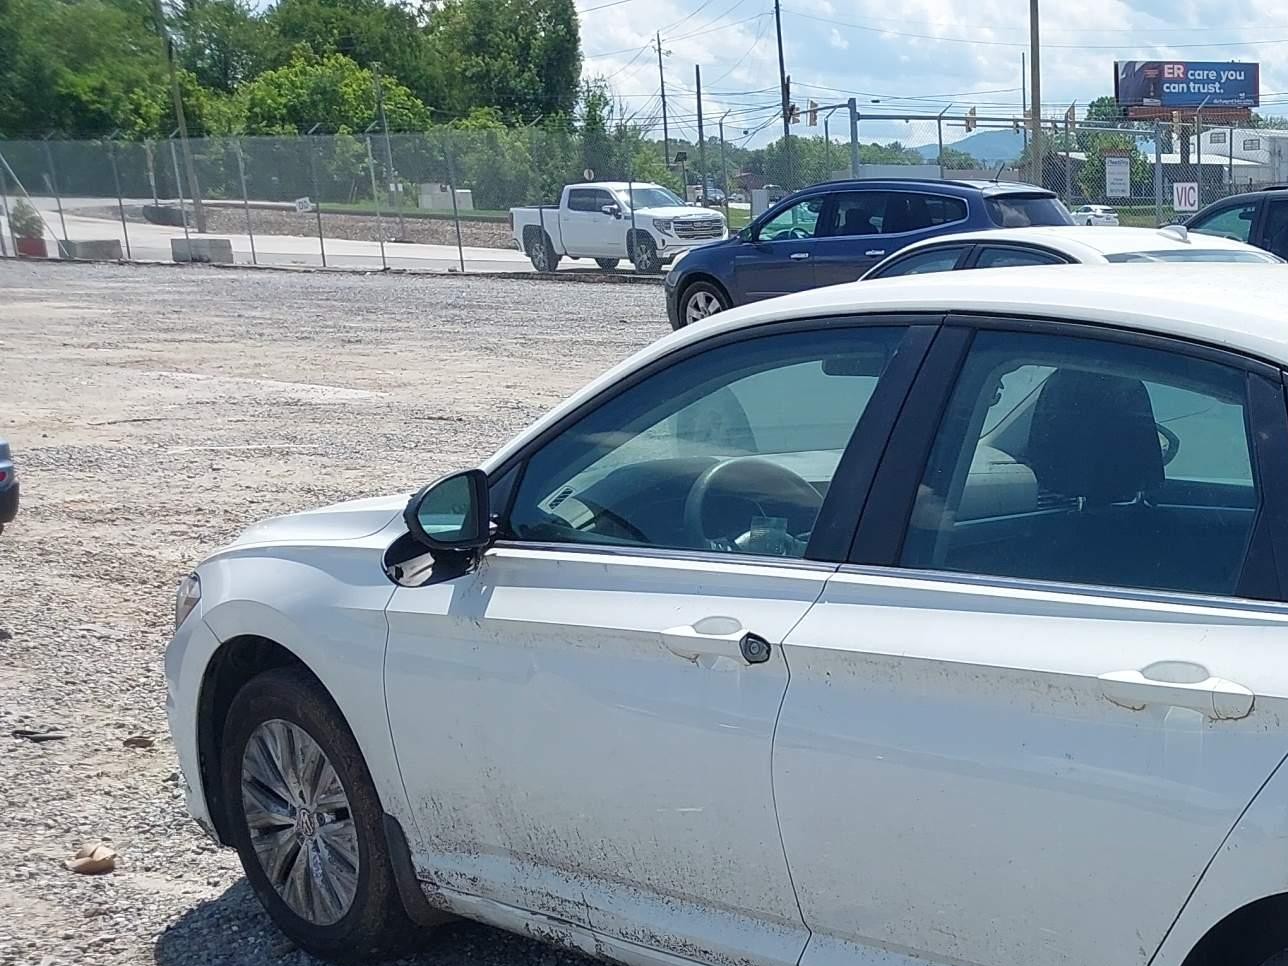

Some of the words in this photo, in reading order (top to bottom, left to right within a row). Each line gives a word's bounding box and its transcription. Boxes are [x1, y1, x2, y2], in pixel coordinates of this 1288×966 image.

[1164, 64, 1185, 78] ER
[1187, 69, 1217, 80] care
[1220, 69, 1245, 82] you
[1163, 81, 1187, 93] can
[1189, 80, 1224, 93] trust.
[1176, 186, 1196, 207] VIC
